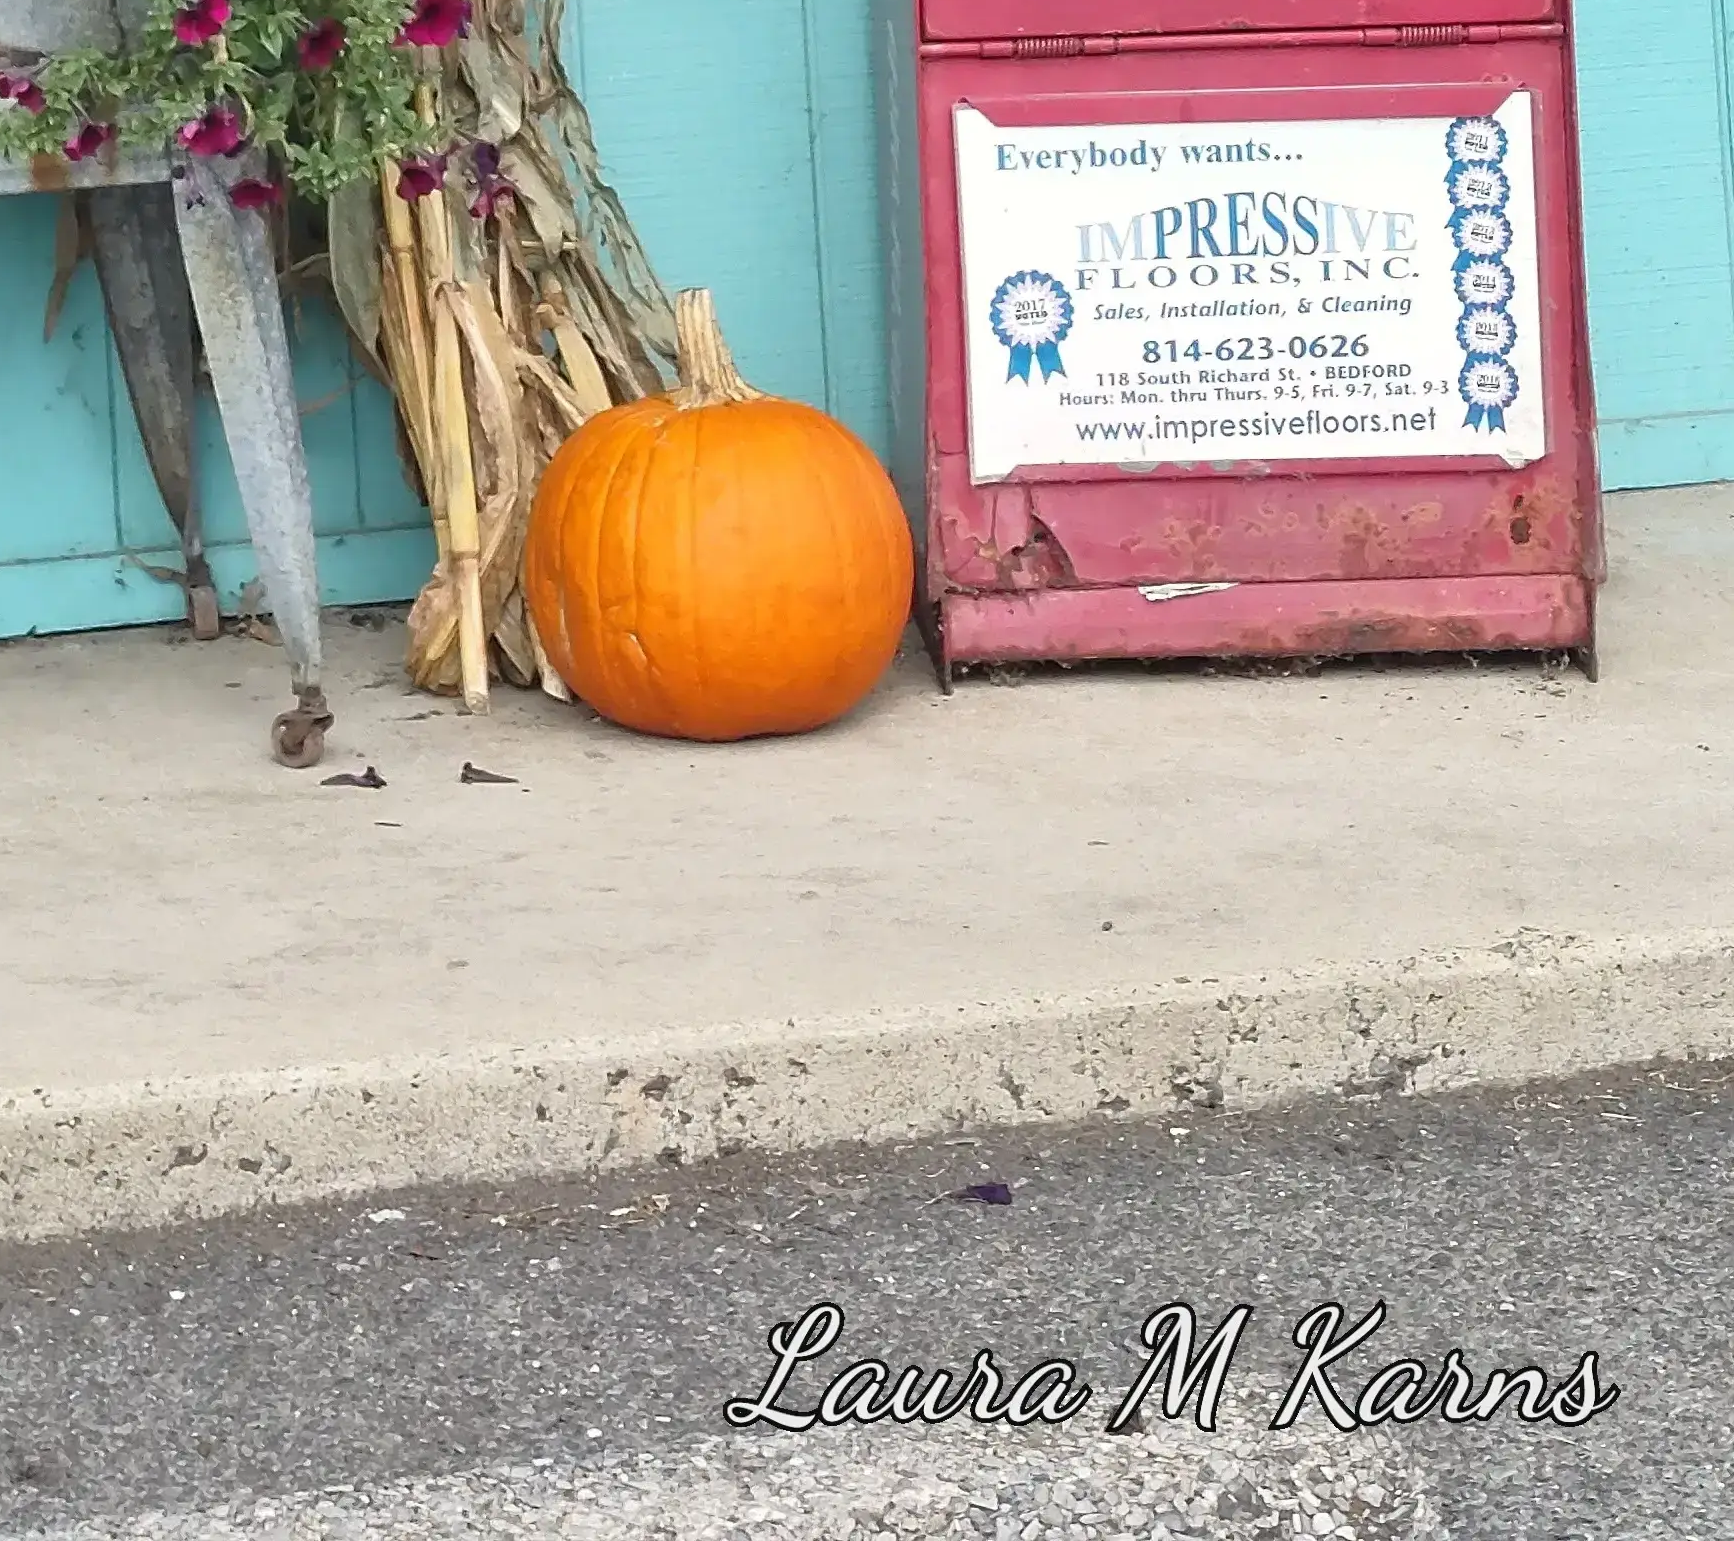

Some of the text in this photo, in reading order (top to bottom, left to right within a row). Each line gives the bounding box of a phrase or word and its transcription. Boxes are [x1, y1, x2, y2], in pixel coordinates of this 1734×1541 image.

[994, 137, 1303, 175] Everybody wants...
[1074, 190, 1419, 263] IMPRESSIVE
[1074, 256, 1420, 291] FLOORS, INC.
[1014, 298, 1045, 313] 2017
[1014, 310, 1048, 321] VOTED
[1093, 294, 1413, 321] Sales, Installation, & Cleaning
[1142, 333, 1370, 364] 814-623-0626
[1096, 364, 1412, 387] 118 South Richard St. BEDFORD
[1059, 379, 1450, 406] Hours: Mon. thru Thurs. 9-5, Fri. 9-7, Sat. 9-3
[1075, 405, 1438, 444] www.impressivefloors.net
